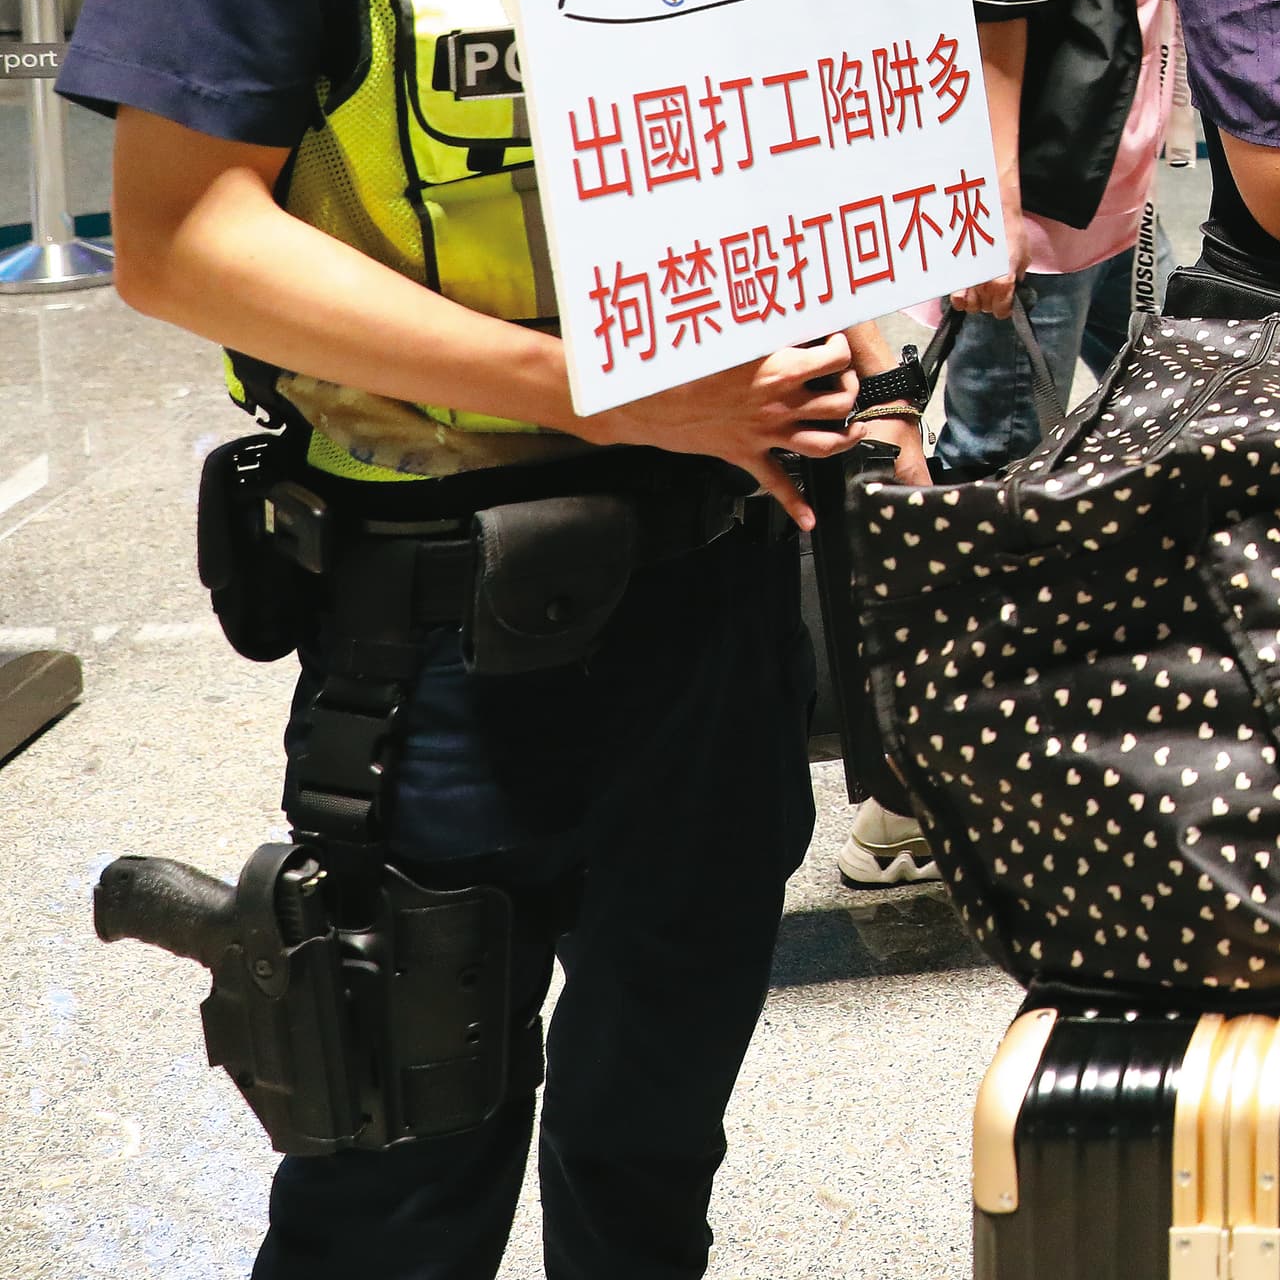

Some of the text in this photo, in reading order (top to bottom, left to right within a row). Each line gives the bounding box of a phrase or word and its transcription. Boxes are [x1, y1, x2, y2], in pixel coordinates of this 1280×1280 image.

[0, 50, 58, 73] port
[568, 32, 971, 201] 出國打工陷阱多
[588, 168, 996, 374] 拘禁毆打回不來
[1135, 201, 1156, 315] MOSCHINO
